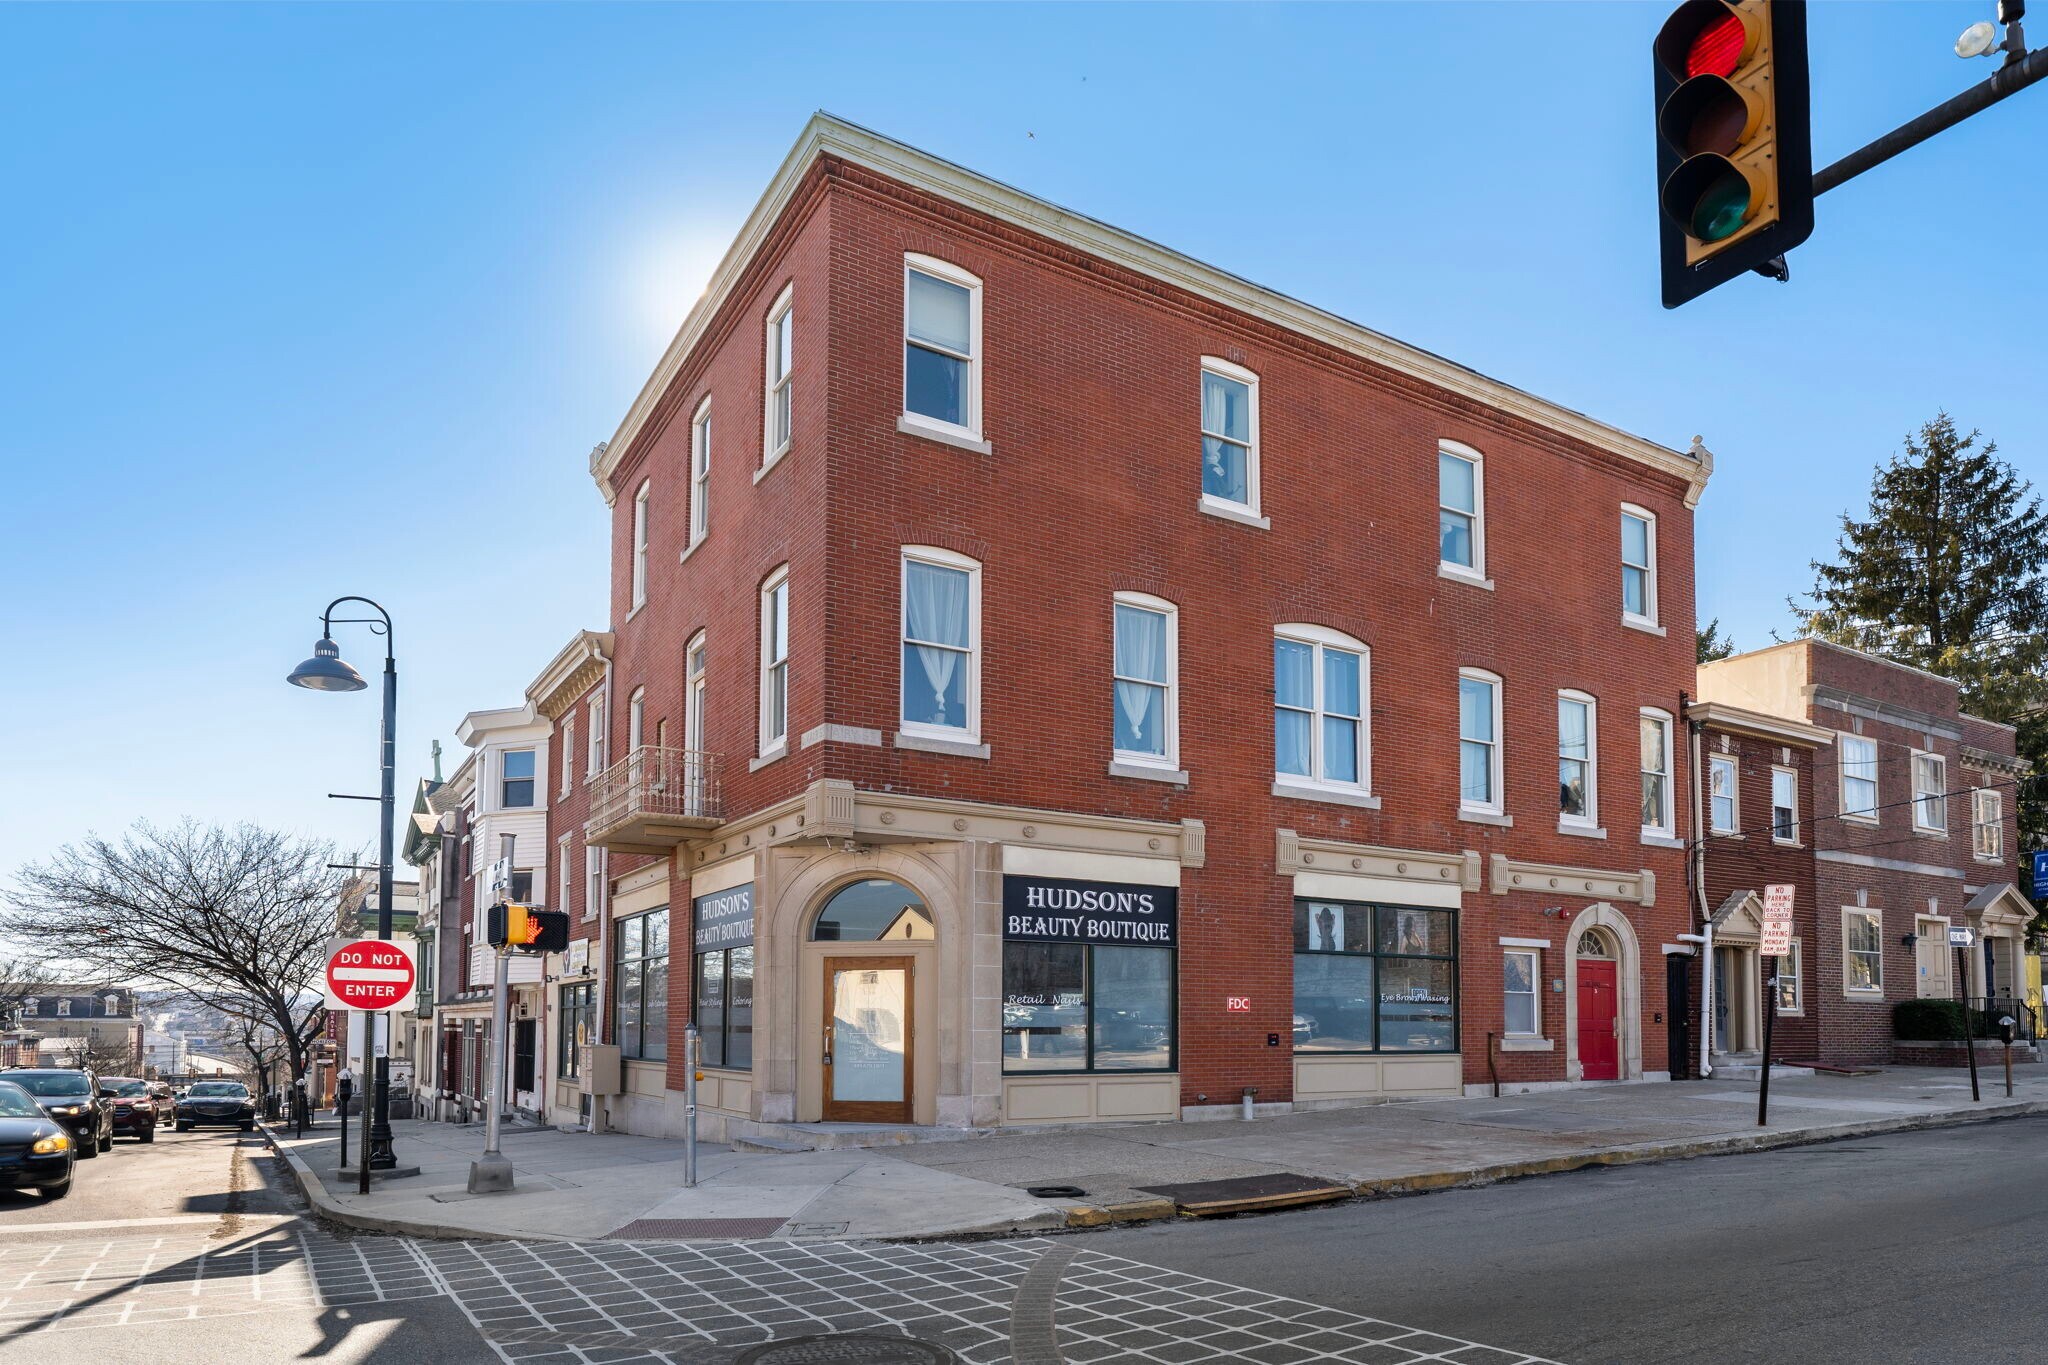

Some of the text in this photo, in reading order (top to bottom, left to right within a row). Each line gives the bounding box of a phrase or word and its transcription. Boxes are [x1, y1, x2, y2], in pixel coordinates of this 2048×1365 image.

[1026, 886, 1155, 914] HUDSON'S
[1767, 894, 1791, 902] PARKING
[702, 891, 749, 921] HUDSON'S
[695, 918, 754, 945] BEAUTY BOUTIQUE
[1008, 915, 1170, 942] BEAUTY BOUTIQUE
[341, 952, 402, 966] DO NOT
[345, 984, 395, 997] ENTER
[1008, 994, 1083, 1005] Retail Nails
[1228, 998, 1249, 1009] FDC
[1380, 993, 1394, 1002] Eye
